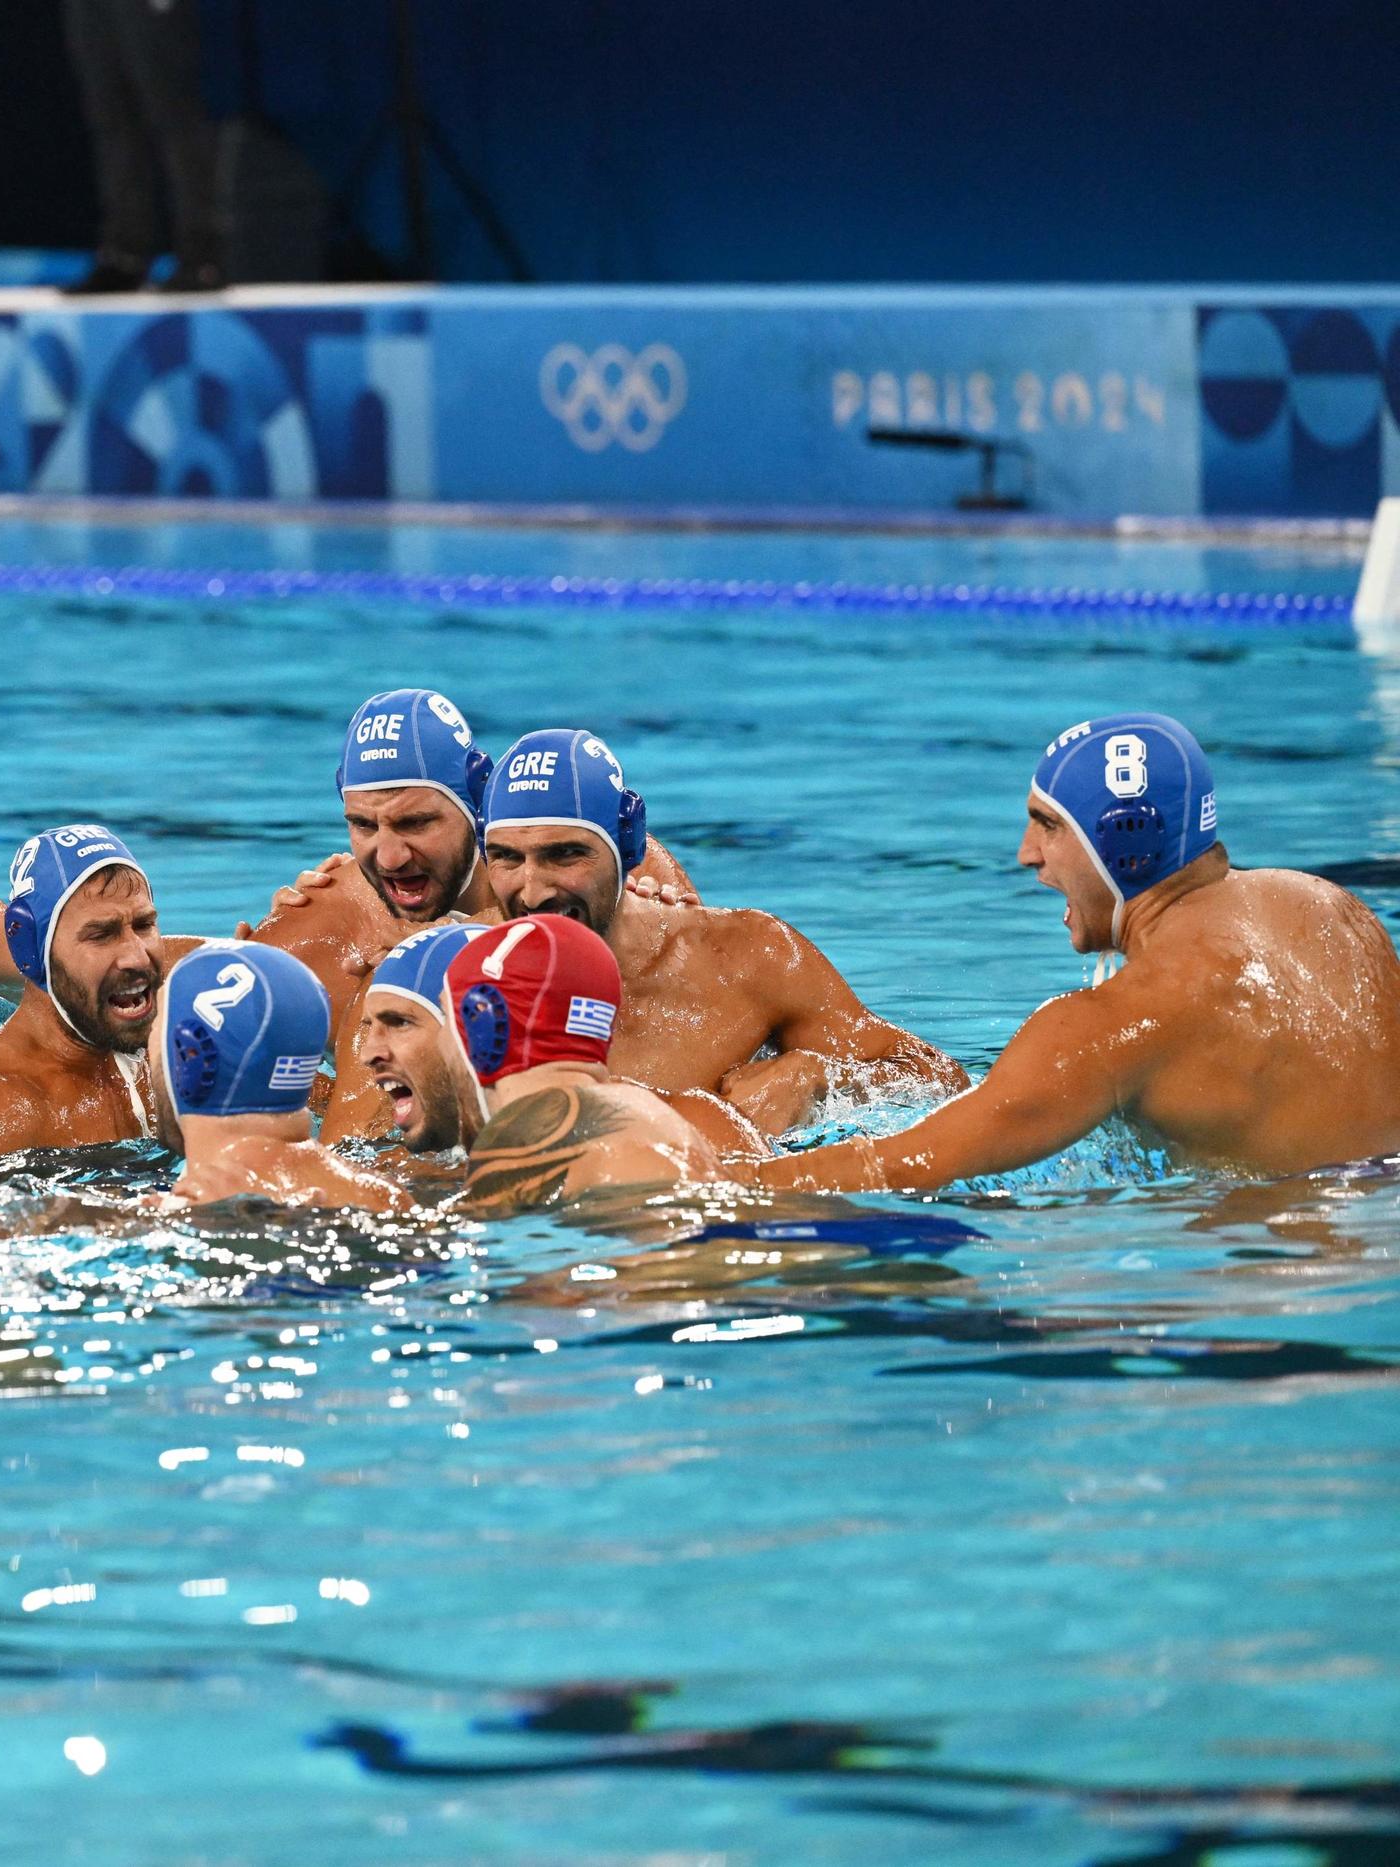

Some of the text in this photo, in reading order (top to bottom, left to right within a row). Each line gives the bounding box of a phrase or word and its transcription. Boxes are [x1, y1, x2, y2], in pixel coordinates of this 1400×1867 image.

[832, 370, 1166, 432] PARIS 2024
[356, 714, 404, 744] GRE
[427, 694, 472, 749] 9
[360, 748, 398, 762] arena
[508, 752, 558, 779] GRE
[1105, 734, 1148, 798] 8
[508, 779, 549, 793] arena
[55, 825, 108, 847] GRE
[77, 843, 116, 857] arena
[481, 922, 536, 980] 1
[193, 963, 256, 1032] 2
